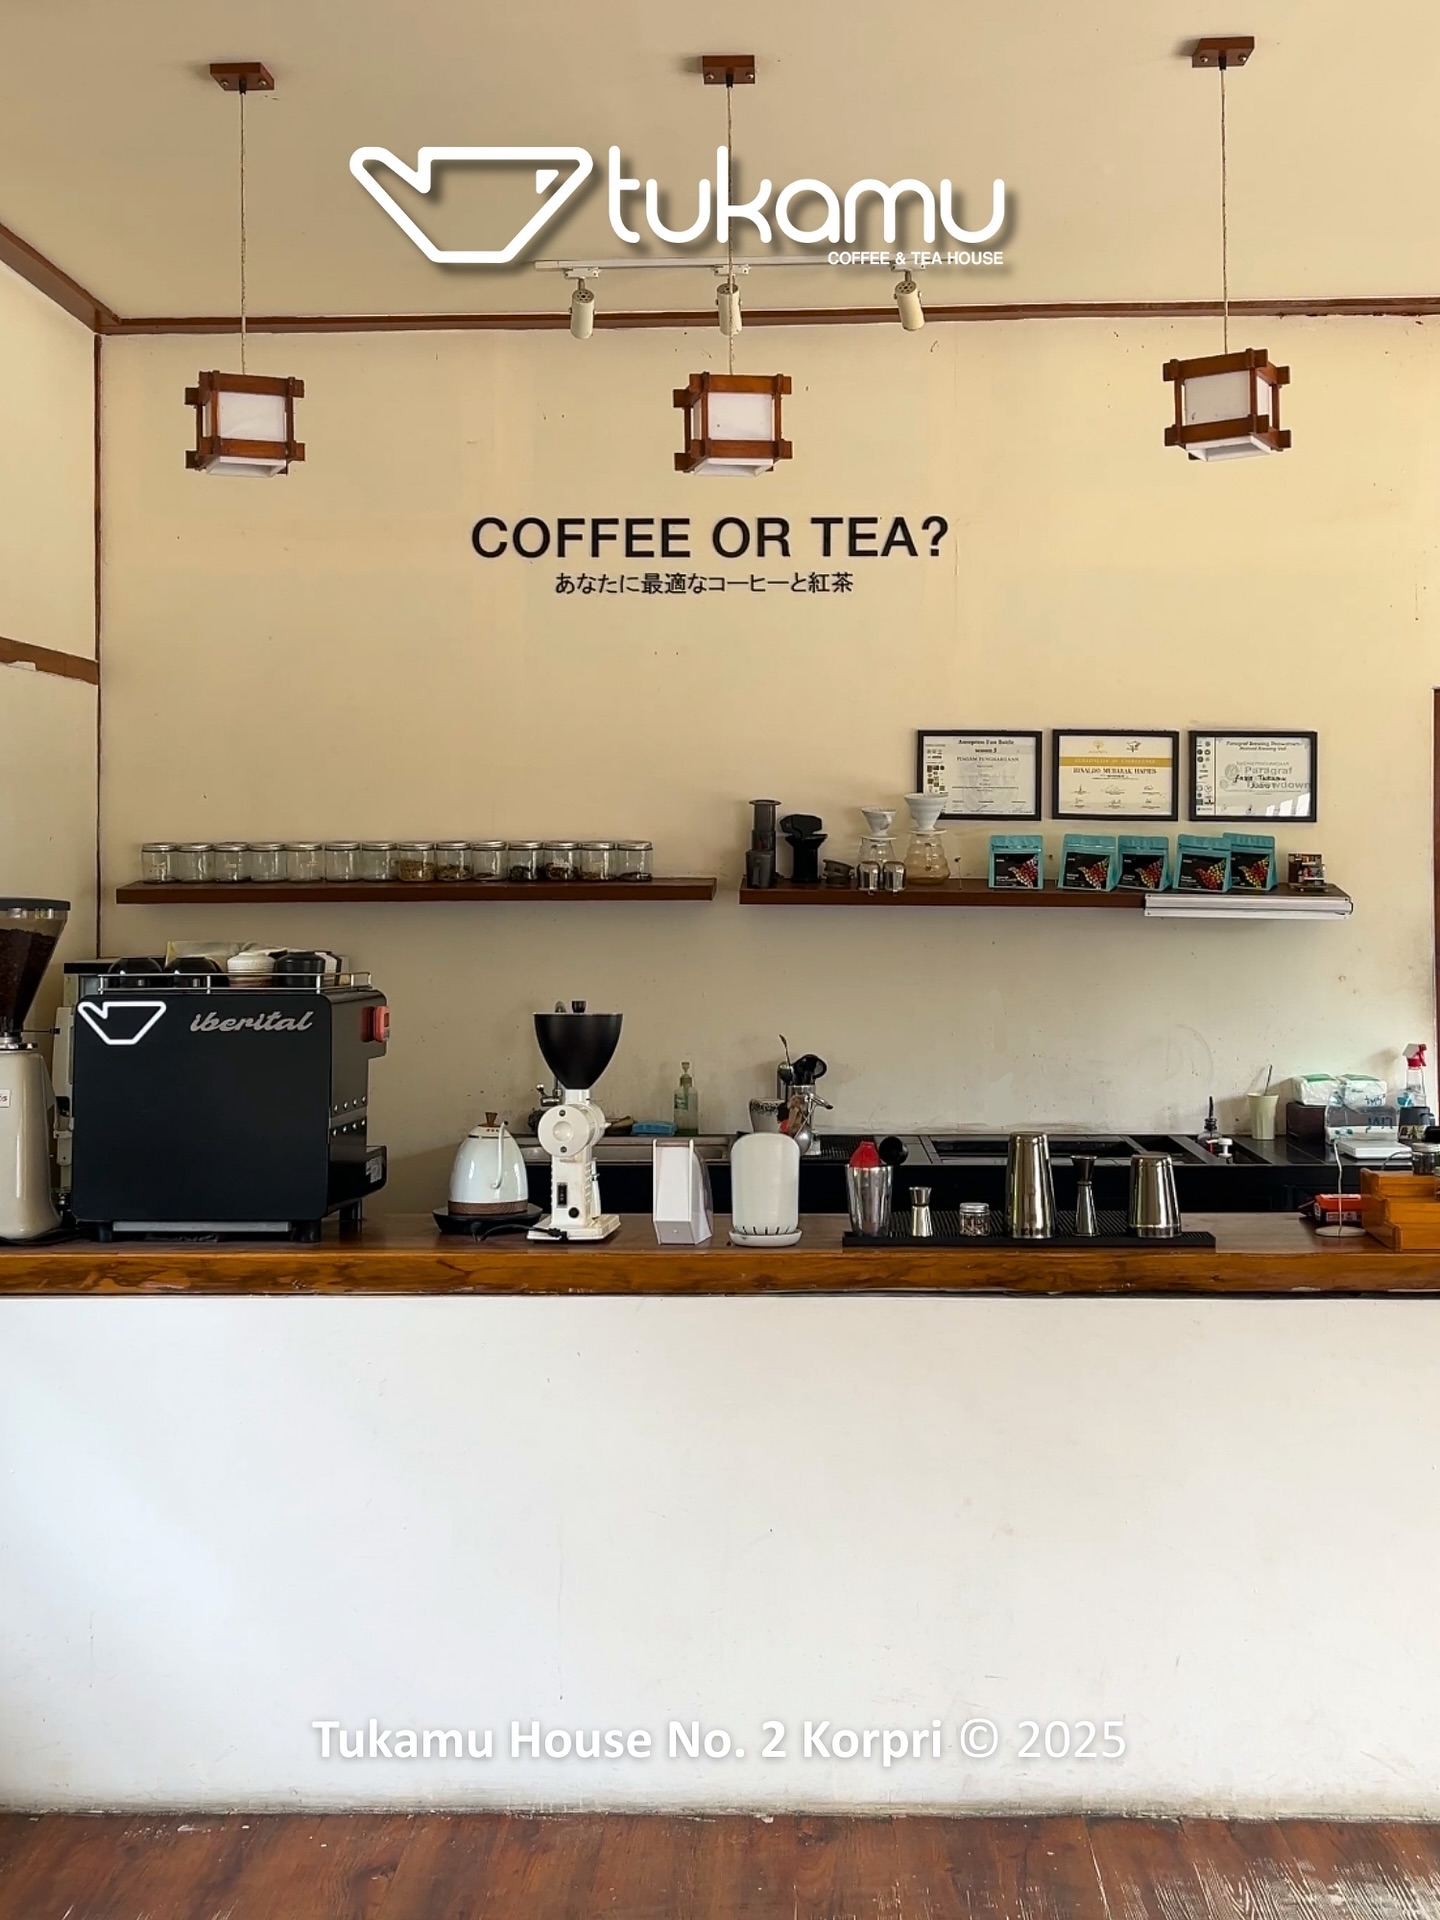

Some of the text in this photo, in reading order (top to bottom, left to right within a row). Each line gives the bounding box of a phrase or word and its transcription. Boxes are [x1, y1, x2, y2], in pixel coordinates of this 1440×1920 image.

[471, 515, 949, 559] COFFEE OR TEA?
[555, 572, 854, 595] あなたに最適なコーヒーと紅茶
[190, 1010, 314, 1033] iberital
